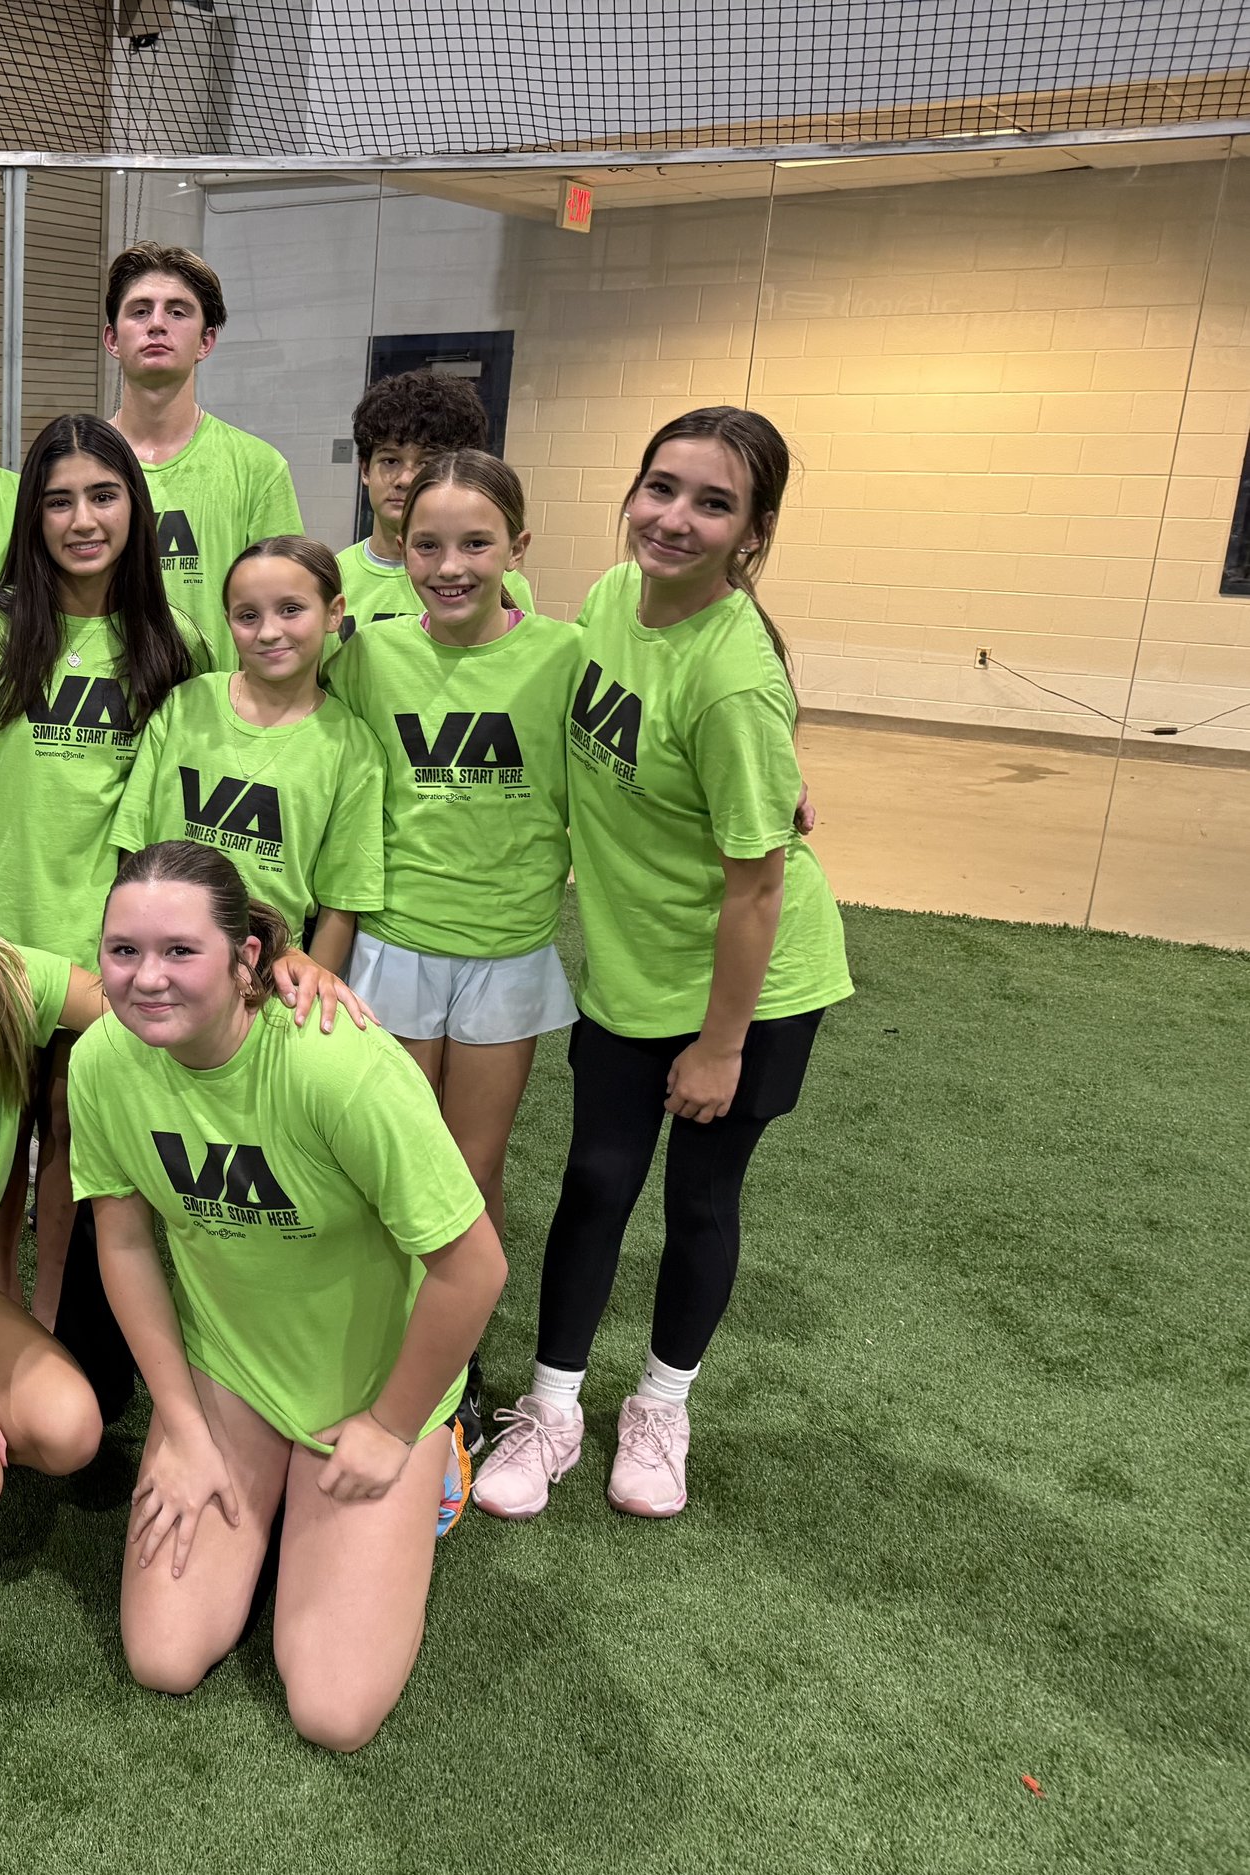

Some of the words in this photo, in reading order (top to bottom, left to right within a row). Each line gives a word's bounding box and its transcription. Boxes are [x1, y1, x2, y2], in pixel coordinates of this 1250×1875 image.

[153, 509, 199, 557] A
[179, 557, 198, 570] HERE
[24, 675, 134, 732] VA
[571, 659, 642, 767] VA
[32, 725, 72, 741] SMILES
[75, 728, 108, 745] START
[111, 731, 134, 747] HERE
[394, 712, 524, 768] VA
[570, 721, 591, 751] SMILES
[592, 741, 612, 768] START
[612, 758, 637, 782] HERE
[415, 768, 454, 783] SMILES
[459, 769, 494, 784] START
[498, 769, 524, 784] HERE
[178, 766, 283, 844] VA
[184, 822, 218, 844] SMILES
[220, 832, 253, 852] START
[255, 840, 282, 858] HERE
[150, 1130, 296, 1210] VA
[227, 1205, 262, 1225] START
[266, 1210, 301, 1227] HERE
